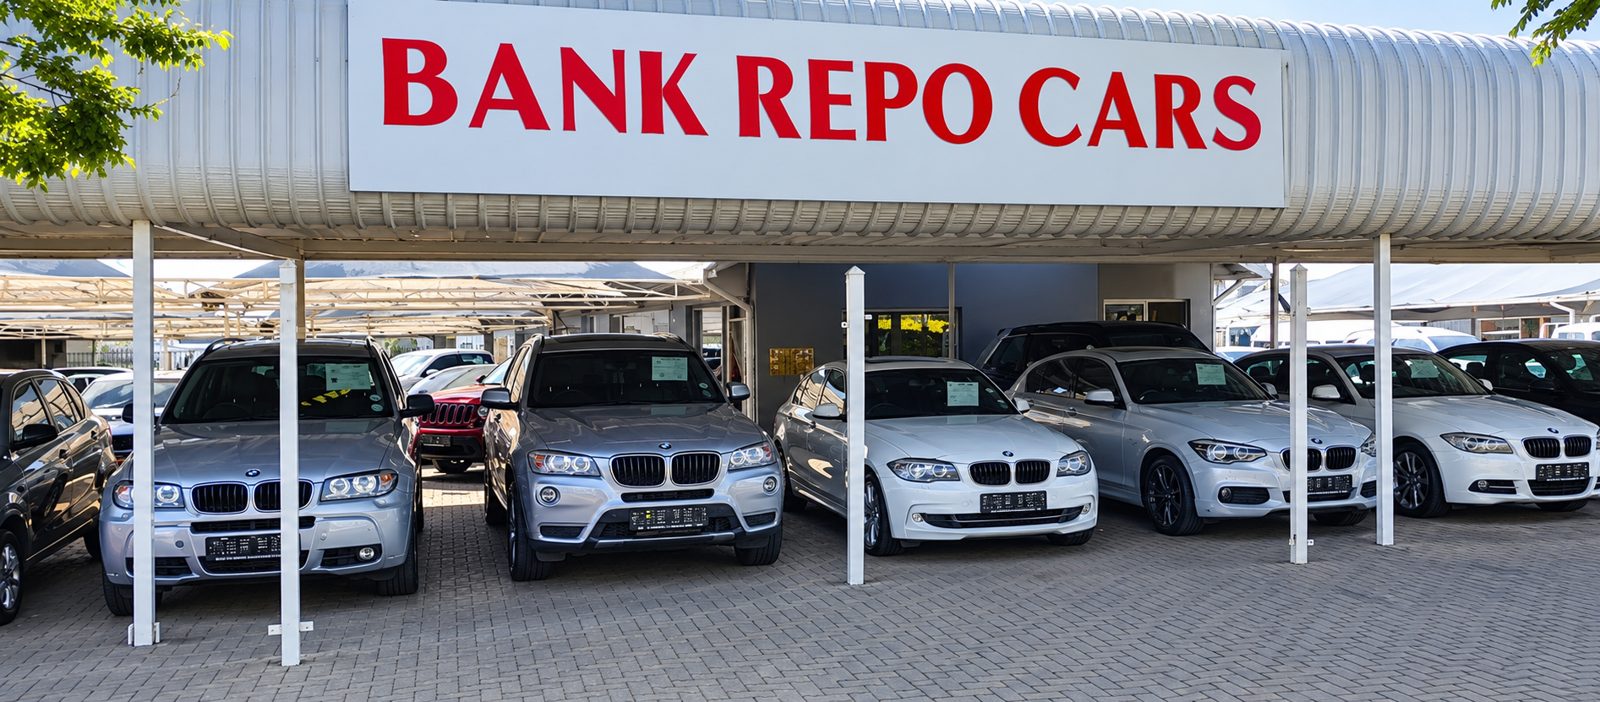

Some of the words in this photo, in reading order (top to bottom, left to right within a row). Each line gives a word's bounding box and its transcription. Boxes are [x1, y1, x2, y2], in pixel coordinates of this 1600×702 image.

[381, 37, 708, 137] BANK
[736, 55, 993, 145] REPO
[1019, 67, 1263, 152] CARS
